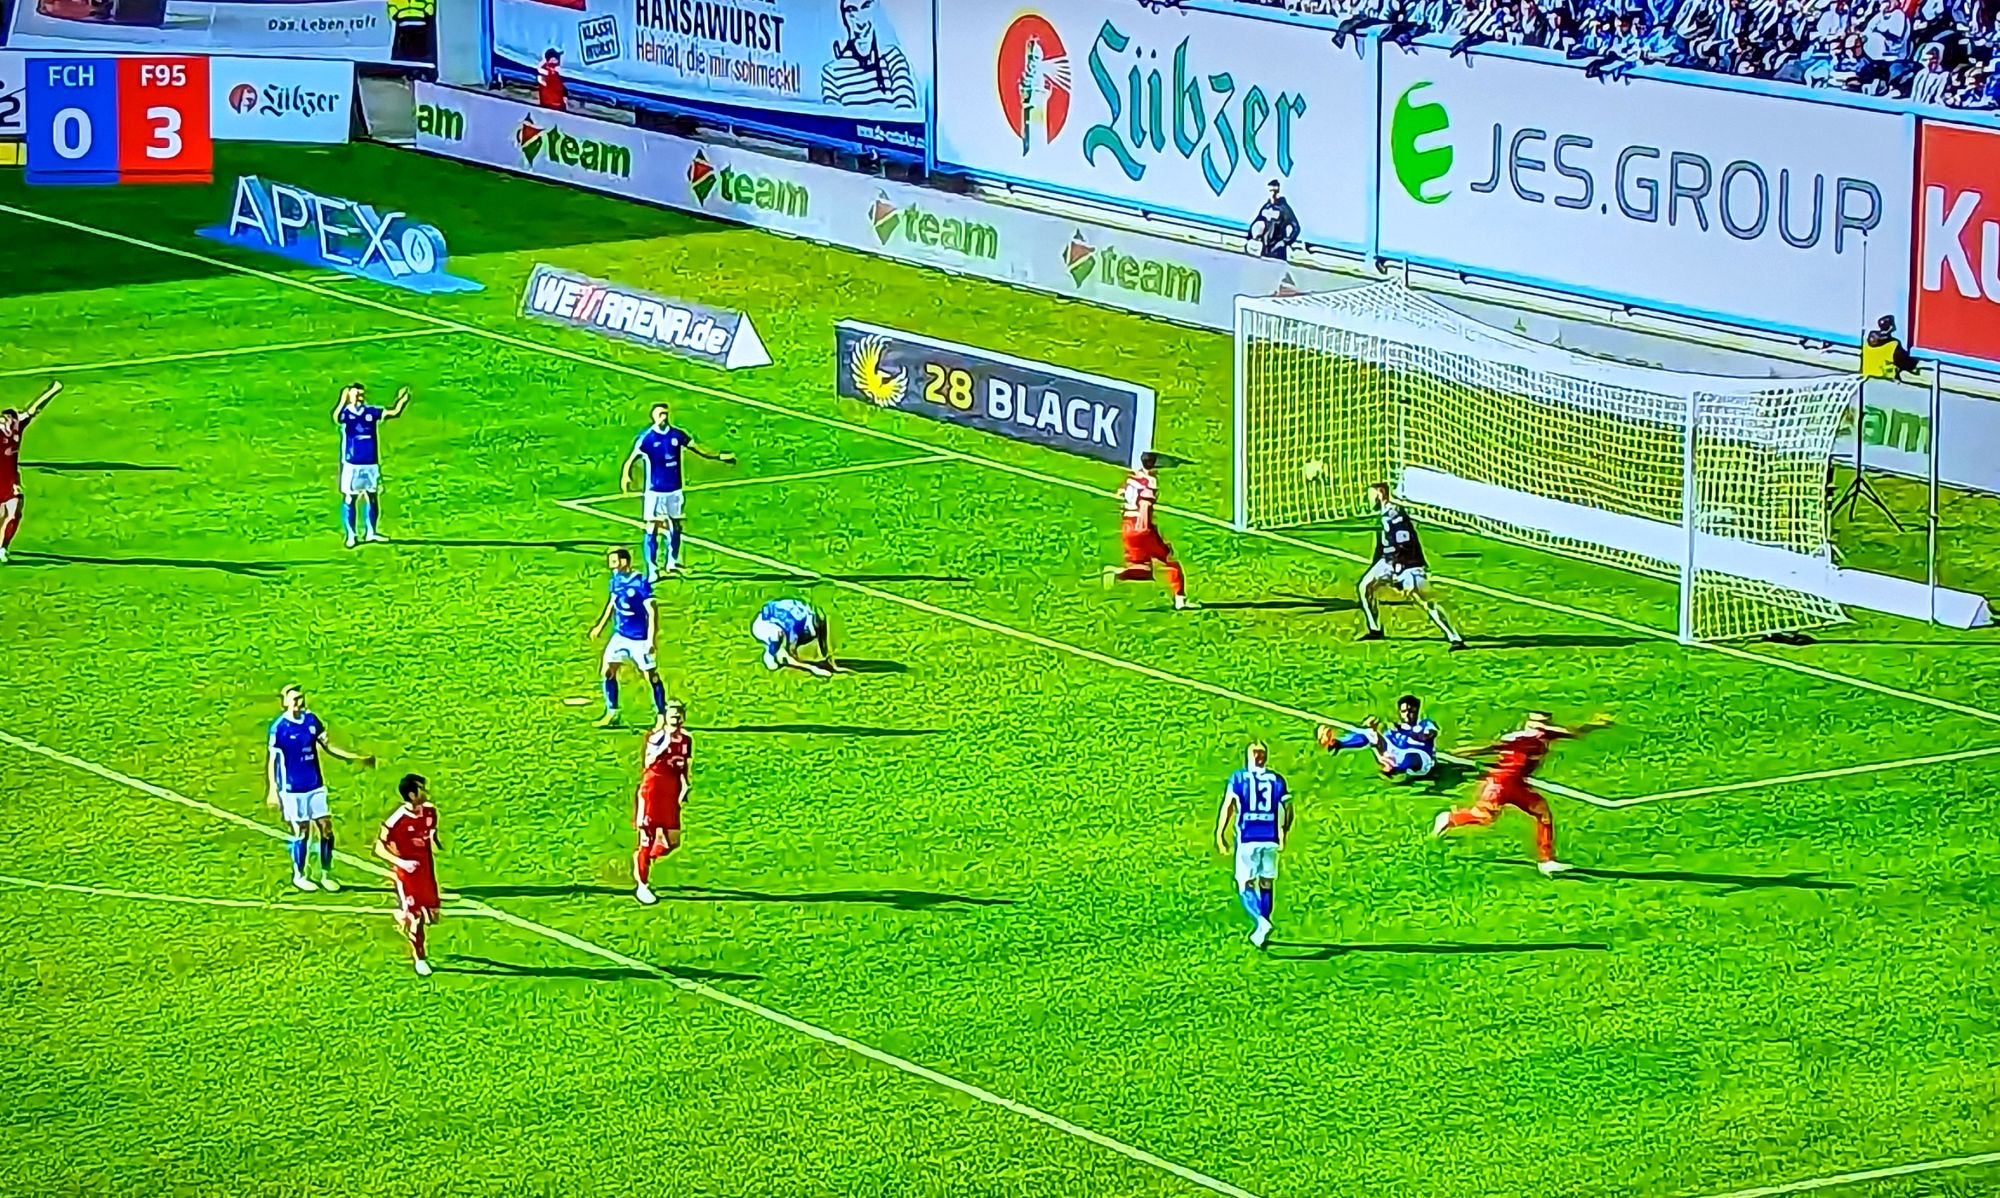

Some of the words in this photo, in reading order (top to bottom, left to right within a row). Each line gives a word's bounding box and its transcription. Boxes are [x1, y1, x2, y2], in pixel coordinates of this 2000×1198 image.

[636, 0, 784, 52] HANSAWURST
[686, 49, 705, 74] die
[709, 55, 731, 78] mir
[416, 103, 465, 142] am
[1083, 18, 1307, 197] Lübzer
[550, 126, 632, 177] team
[721, 167, 809, 217] team
[1469, 123, 1883, 254] JES.GROUP
[229, 176, 411, 277] APEX
[904, 205, 998, 260] team
[1102, 246, 1202, 304] team
[923, 363, 975, 411] 28
[987, 377, 1121, 448] BLACK
[1862, 405, 1930, 454] am
[1243, 771, 1277, 812] 13
